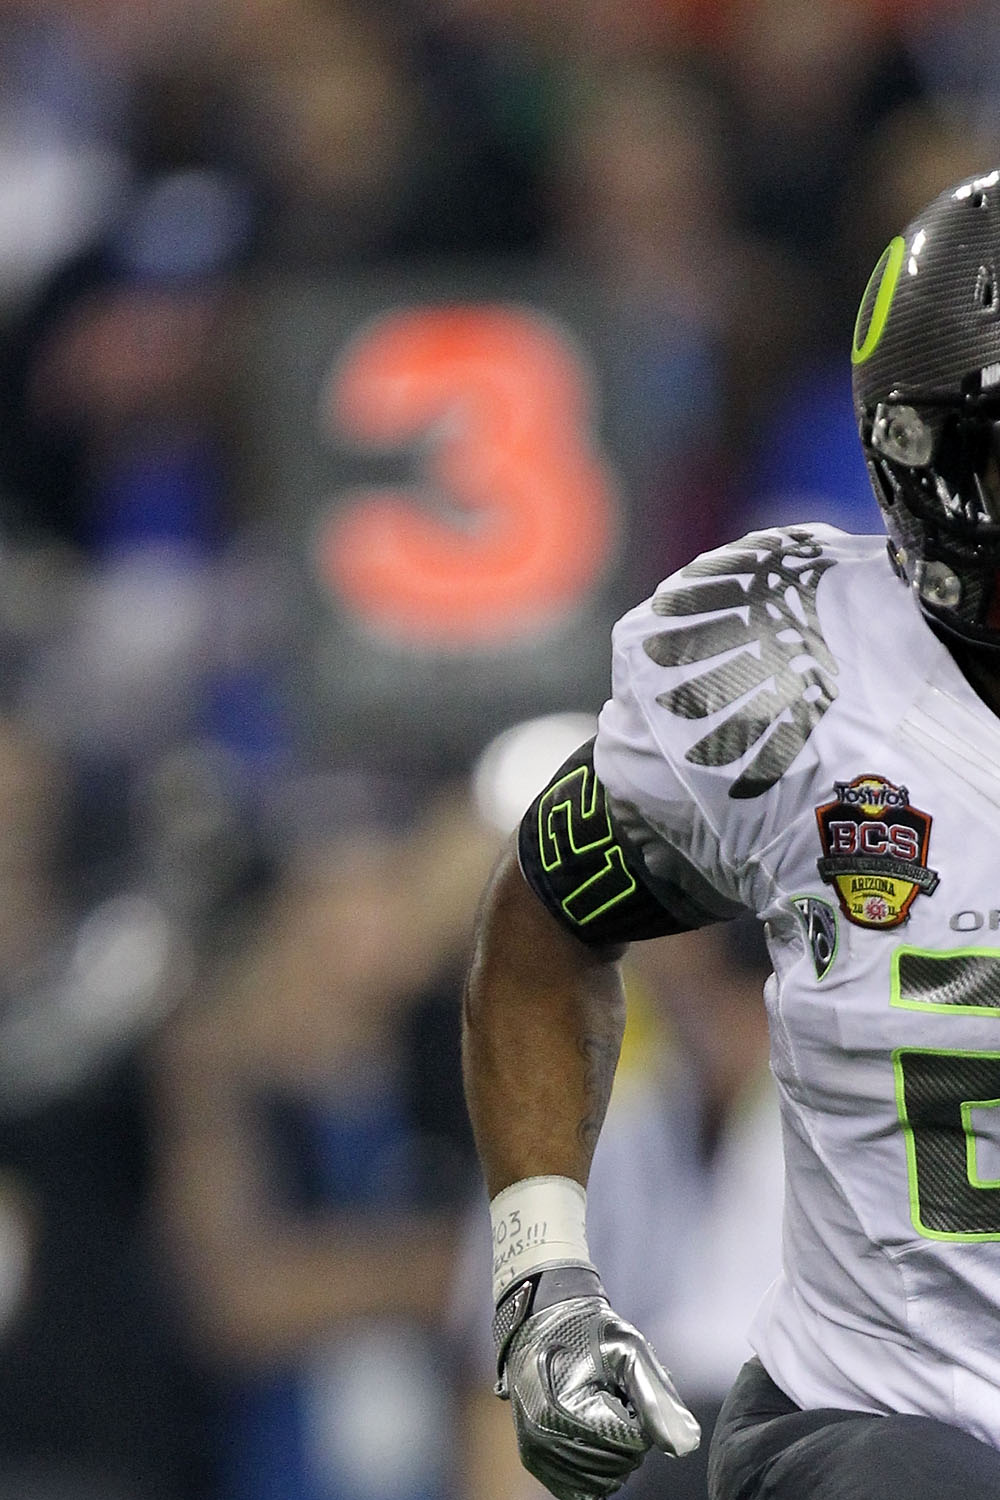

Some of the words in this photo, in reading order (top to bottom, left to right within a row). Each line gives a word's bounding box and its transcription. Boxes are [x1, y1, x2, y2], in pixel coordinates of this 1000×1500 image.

[318, 300, 616, 648] 3
[537, 765, 637, 926] 21
[828, 821, 919, 861] BCS
[851, 877, 896, 897] ARIZONA
